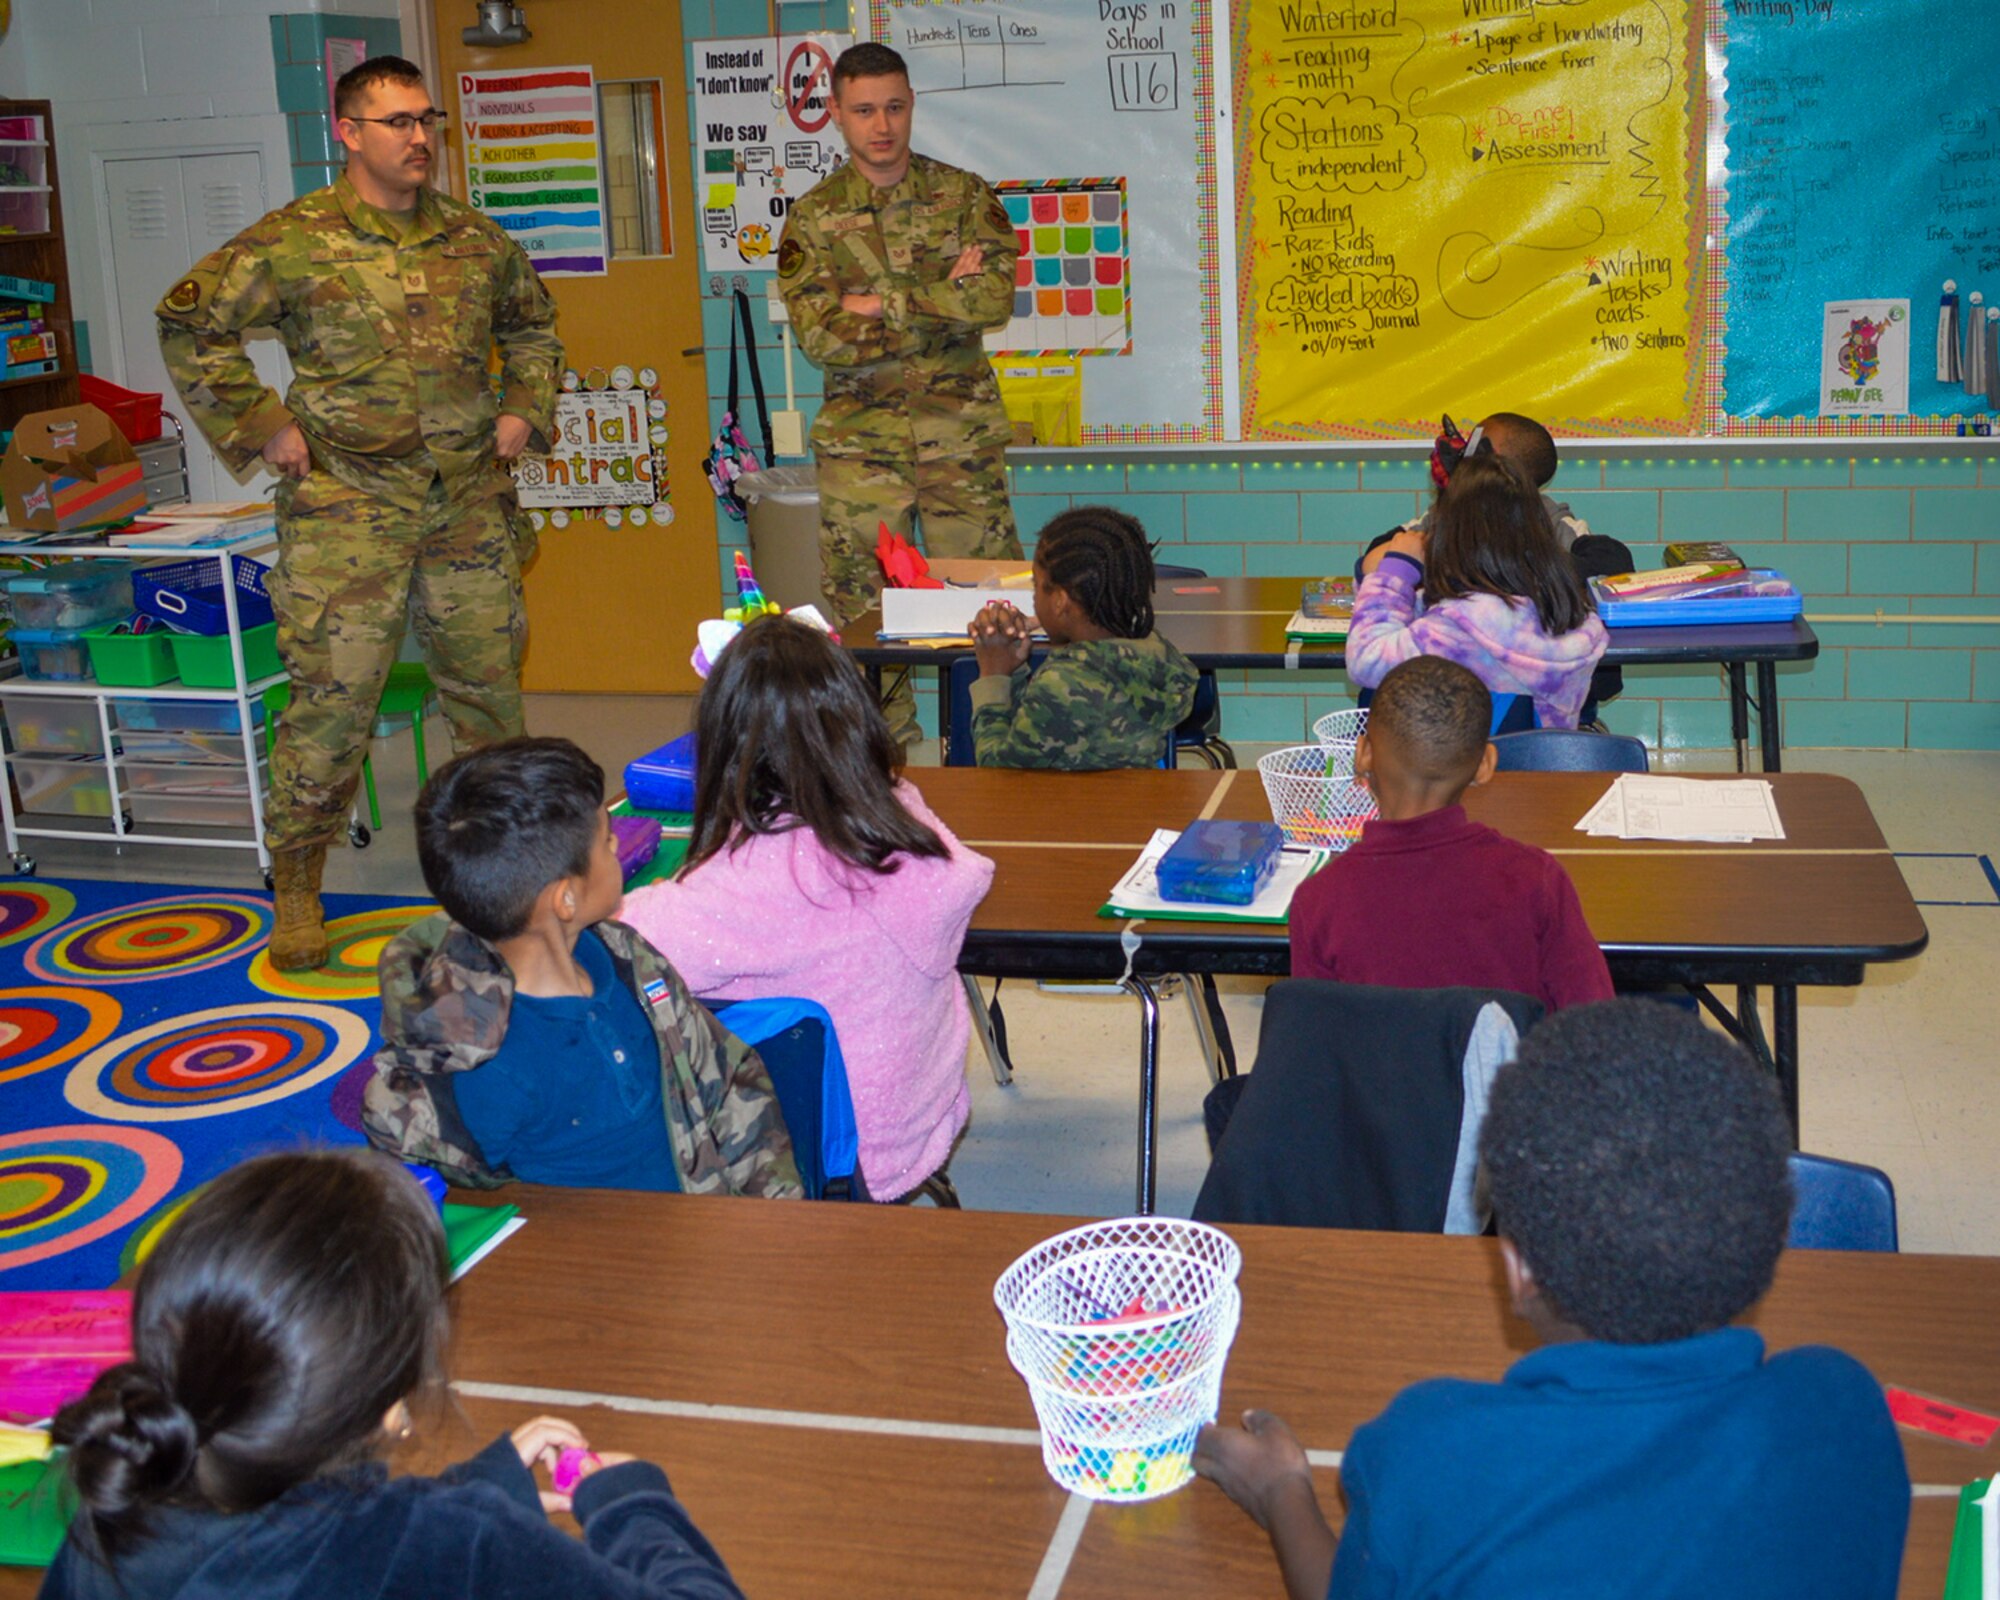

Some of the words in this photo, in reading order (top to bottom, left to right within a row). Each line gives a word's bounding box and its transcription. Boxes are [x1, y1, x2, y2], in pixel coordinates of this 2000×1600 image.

[1099, 0, 1147, 33] Days
[1161, 3, 1176, 19] in
[1279, 0, 1398, 33] Waterford
[906, 28, 957, 45] Hundreds
[964, 25, 991, 38] Tens
[1008, 24, 1038, 38] Ones
[1106, 26, 1164, 50] School
[1527, 22, 1548, 42] of
[705, 49, 750, 70] Instead
[752, 48, 763, 68] of
[1561, 50, 1597, 69] fixer
[708, 76, 737, 95] don't
[1120, 61, 1169, 104] 116
[1487, 106, 1523, 127] Do
[706, 124, 734, 143] We
[738, 125, 767, 143] say
[1275, 112, 1384, 153] Stations
[504, 148, 537, 161] OTHER
[1487, 131, 1610, 165] Assessment
[541, 170, 556, 181] OF
[759, 176, 765, 188] 1
[1274, 195, 1356, 236] Reading
[720, 237, 727, 249] 3
[1601, 249, 1672, 289] Writing
[1360, 280, 1412, 307] books
[1600, 279, 1662, 304] tasks
[1598, 329, 1629, 352] two
